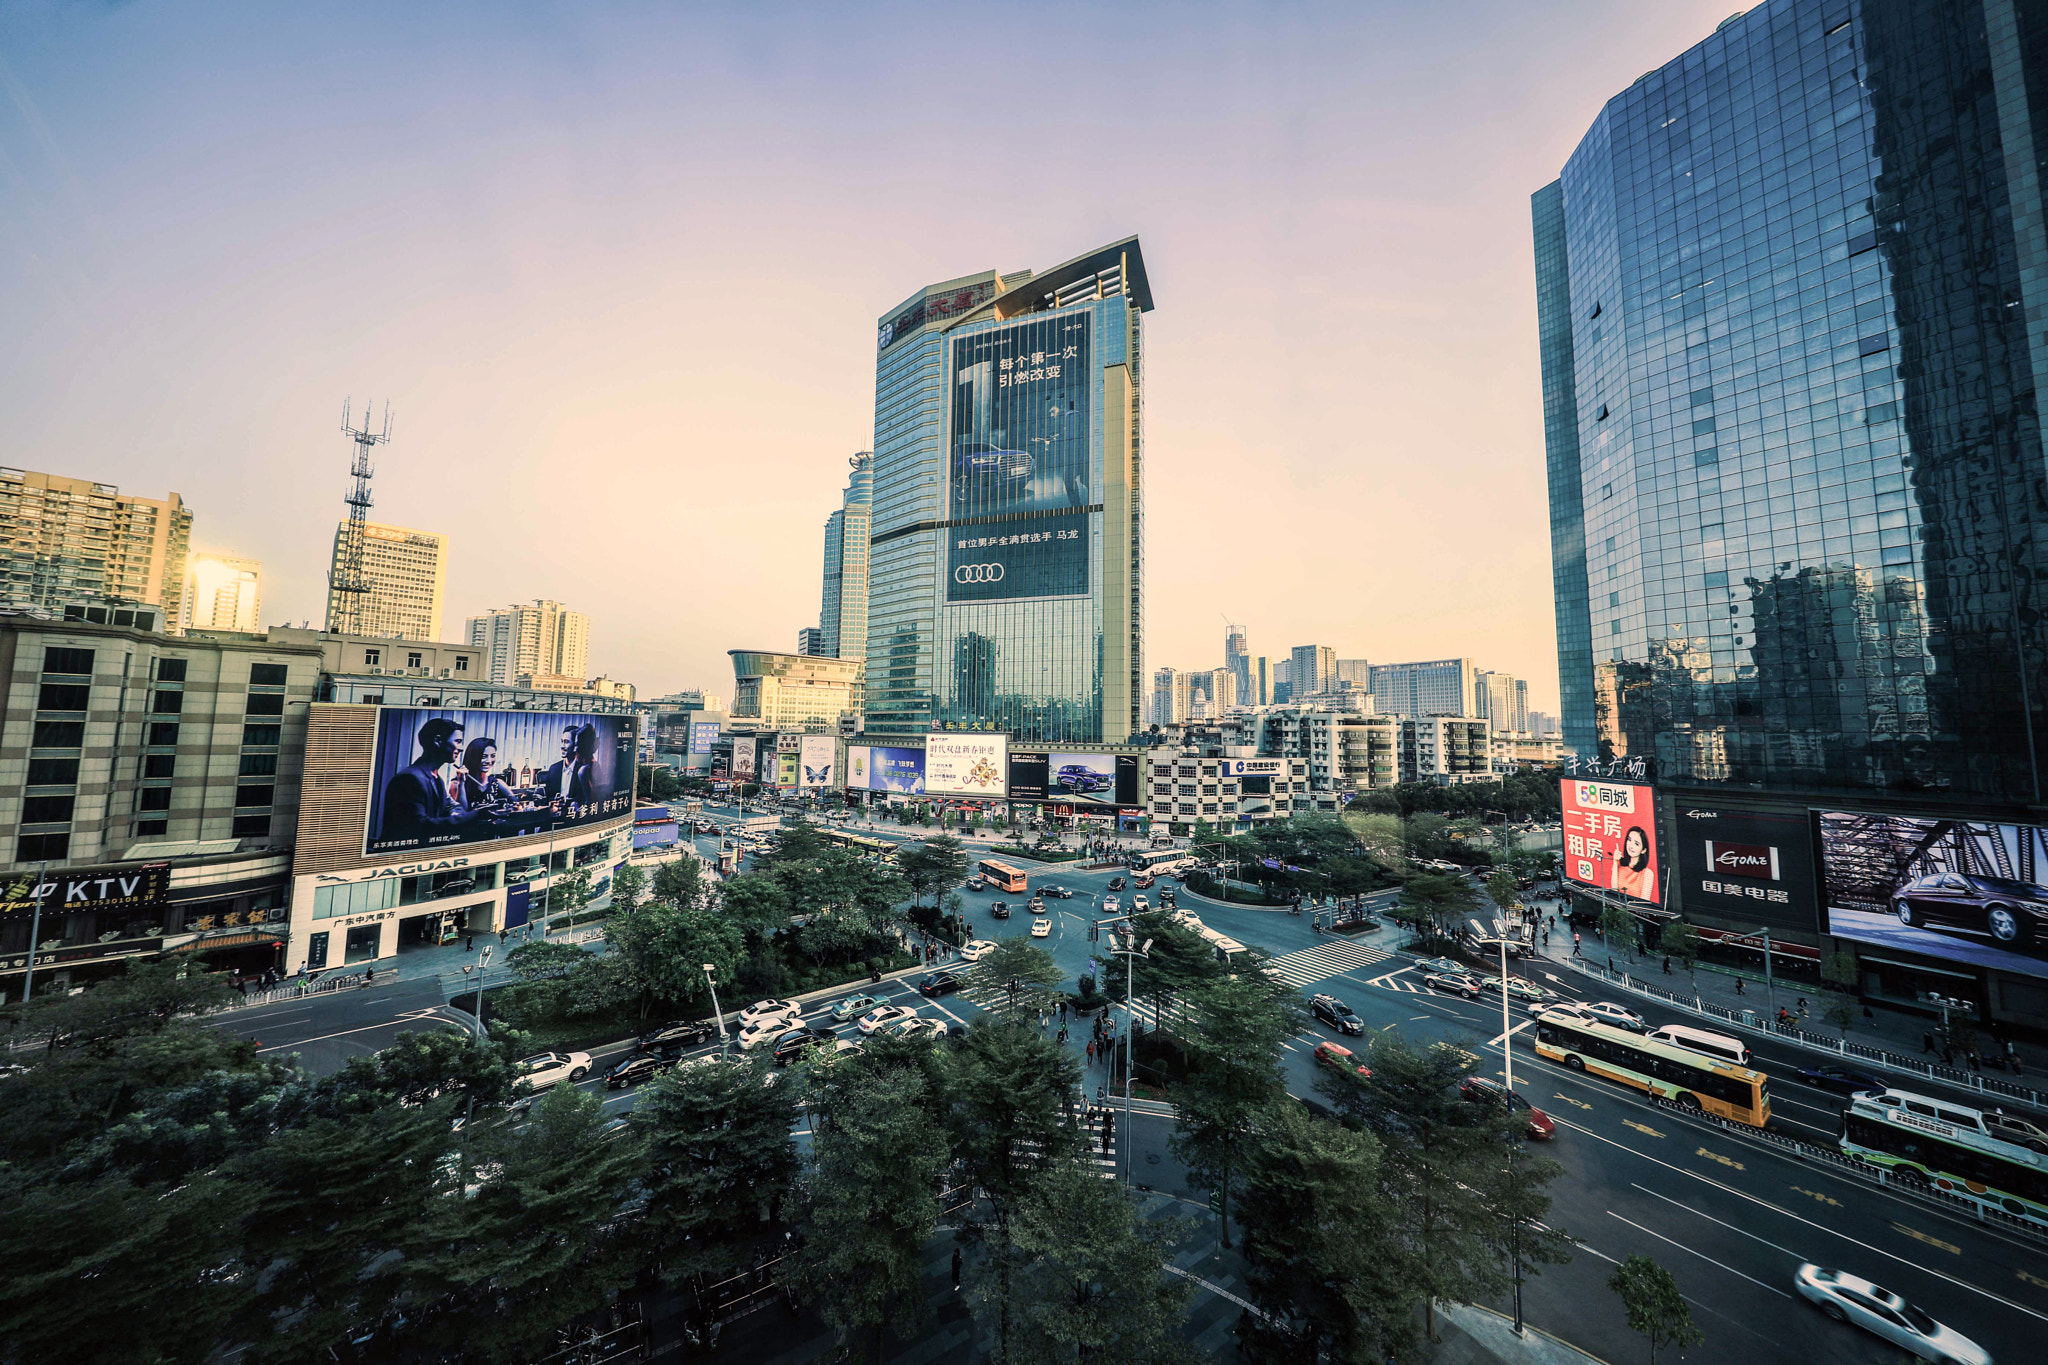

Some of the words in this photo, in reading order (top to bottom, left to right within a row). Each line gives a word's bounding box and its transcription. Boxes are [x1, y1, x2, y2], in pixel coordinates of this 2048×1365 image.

[1000, 345, 1077, 371] 每个第一次
[999, 365, 1061, 388] 引燃改变
[365, 527, 406, 541] 4399
[957, 531, 1053, 550] 首位男乒全满贯选手
[1056, 528, 1079, 540] 马龙
[1566, 752, 1646, 779] 丰兴广场
[1580, 784, 1629, 808] 58同城
[633, 826, 660, 835] oolpad
[1566, 809, 1622, 839] 二手房
[1567, 834, 1604, 862] 租房
[360, 857, 470, 880] JAGUAR
[1580, 863, 1592, 877] 58
[66, 875, 142, 903] KTV
[1702, 880, 1789, 904] 国美电器
[84, 895, 139, 908] 87530108
[333, 911, 396, 928] 广东中汽南方
